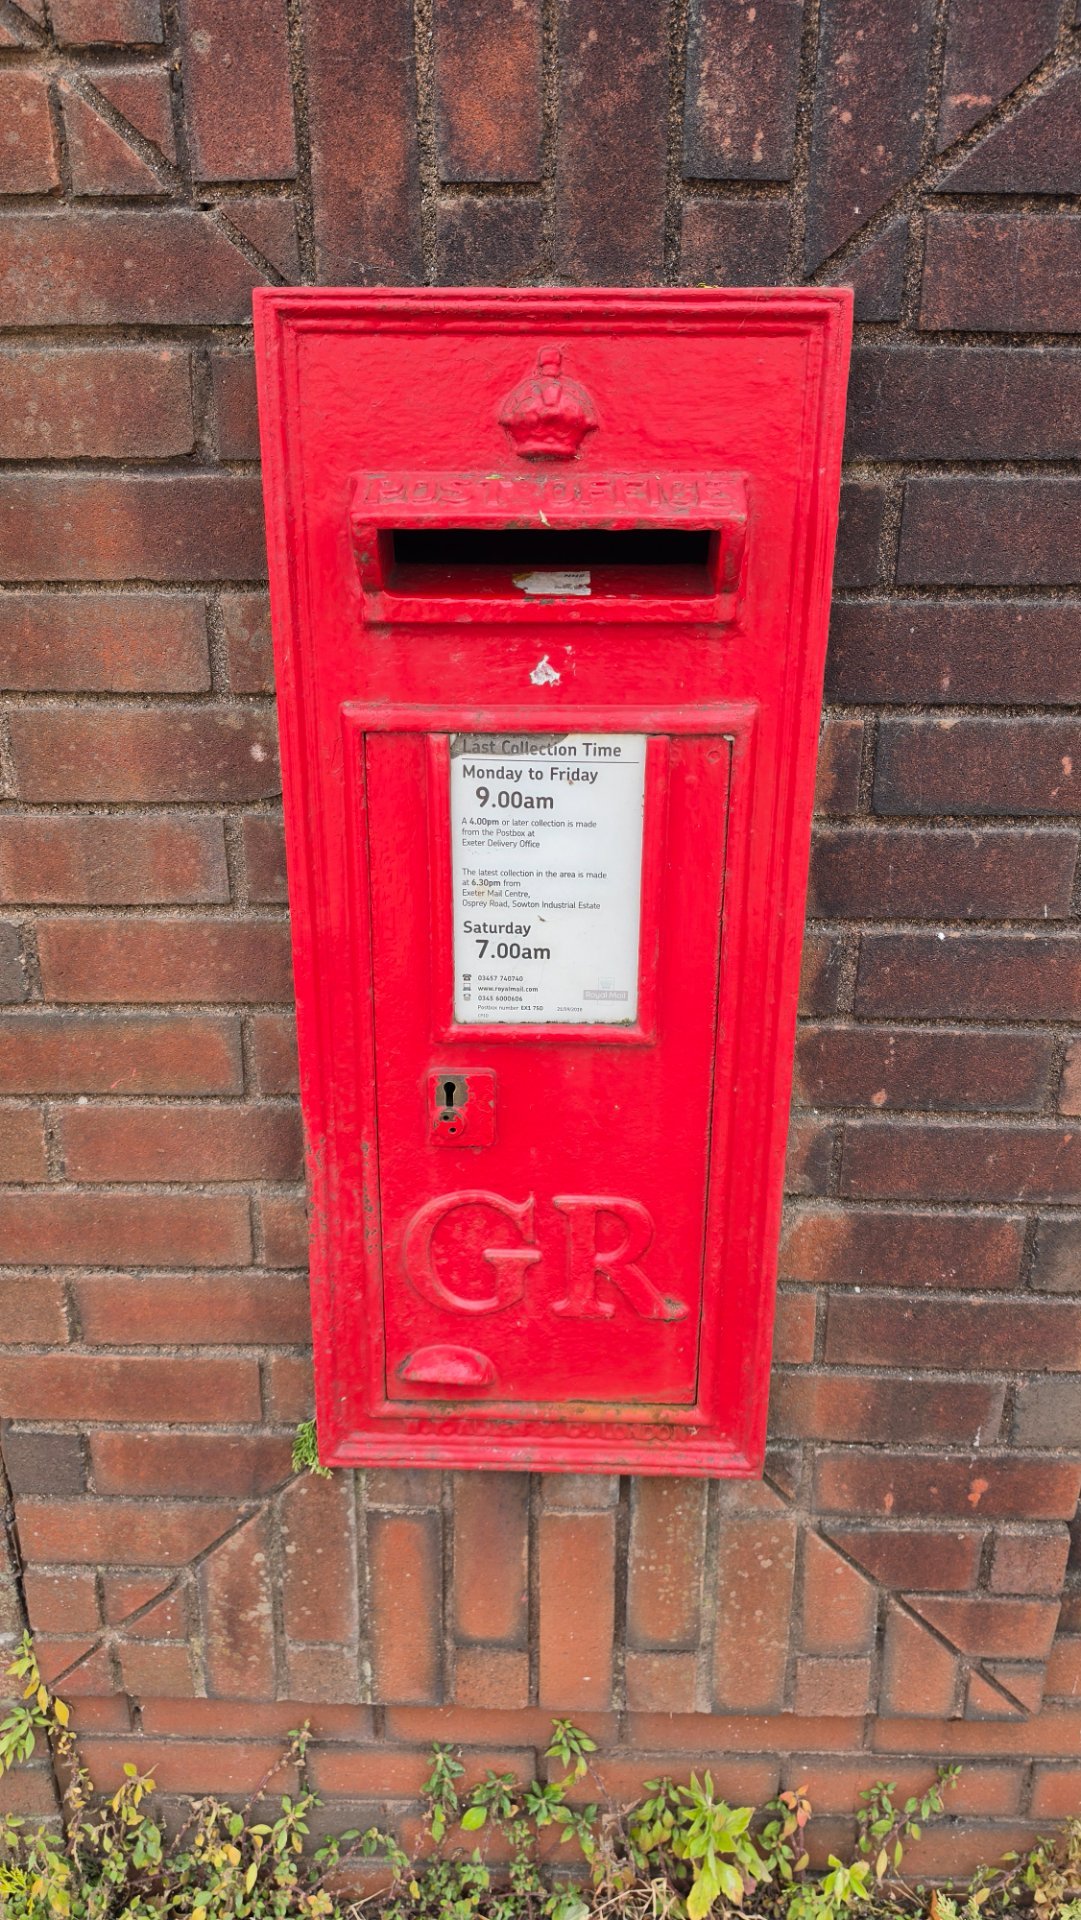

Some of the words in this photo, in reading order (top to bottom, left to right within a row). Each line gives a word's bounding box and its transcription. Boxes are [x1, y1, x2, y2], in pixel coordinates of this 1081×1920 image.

[366, 477, 501, 505] POST
[549, 478, 738, 507] OFFICE
[463, 739, 495, 753] Last
[502, 740, 577, 756] Collection
[582, 743, 622, 757] Time
[463, 765, 523, 782] Monday
[528, 768, 543, 780] to
[550, 767, 598, 784] Friday
[476, 787, 553, 809] 9.00am
[469, 818, 499, 827] 4.00pm
[462, 839, 485, 847] Exeter
[488, 840, 517, 848] Delivery
[471, 879, 501, 887] 6.30pm
[463, 900, 487, 908] Osprey
[463, 921, 531, 936] Saturday
[476, 940, 550, 959] 7.00am
[585, 991, 607, 1000] Royal
